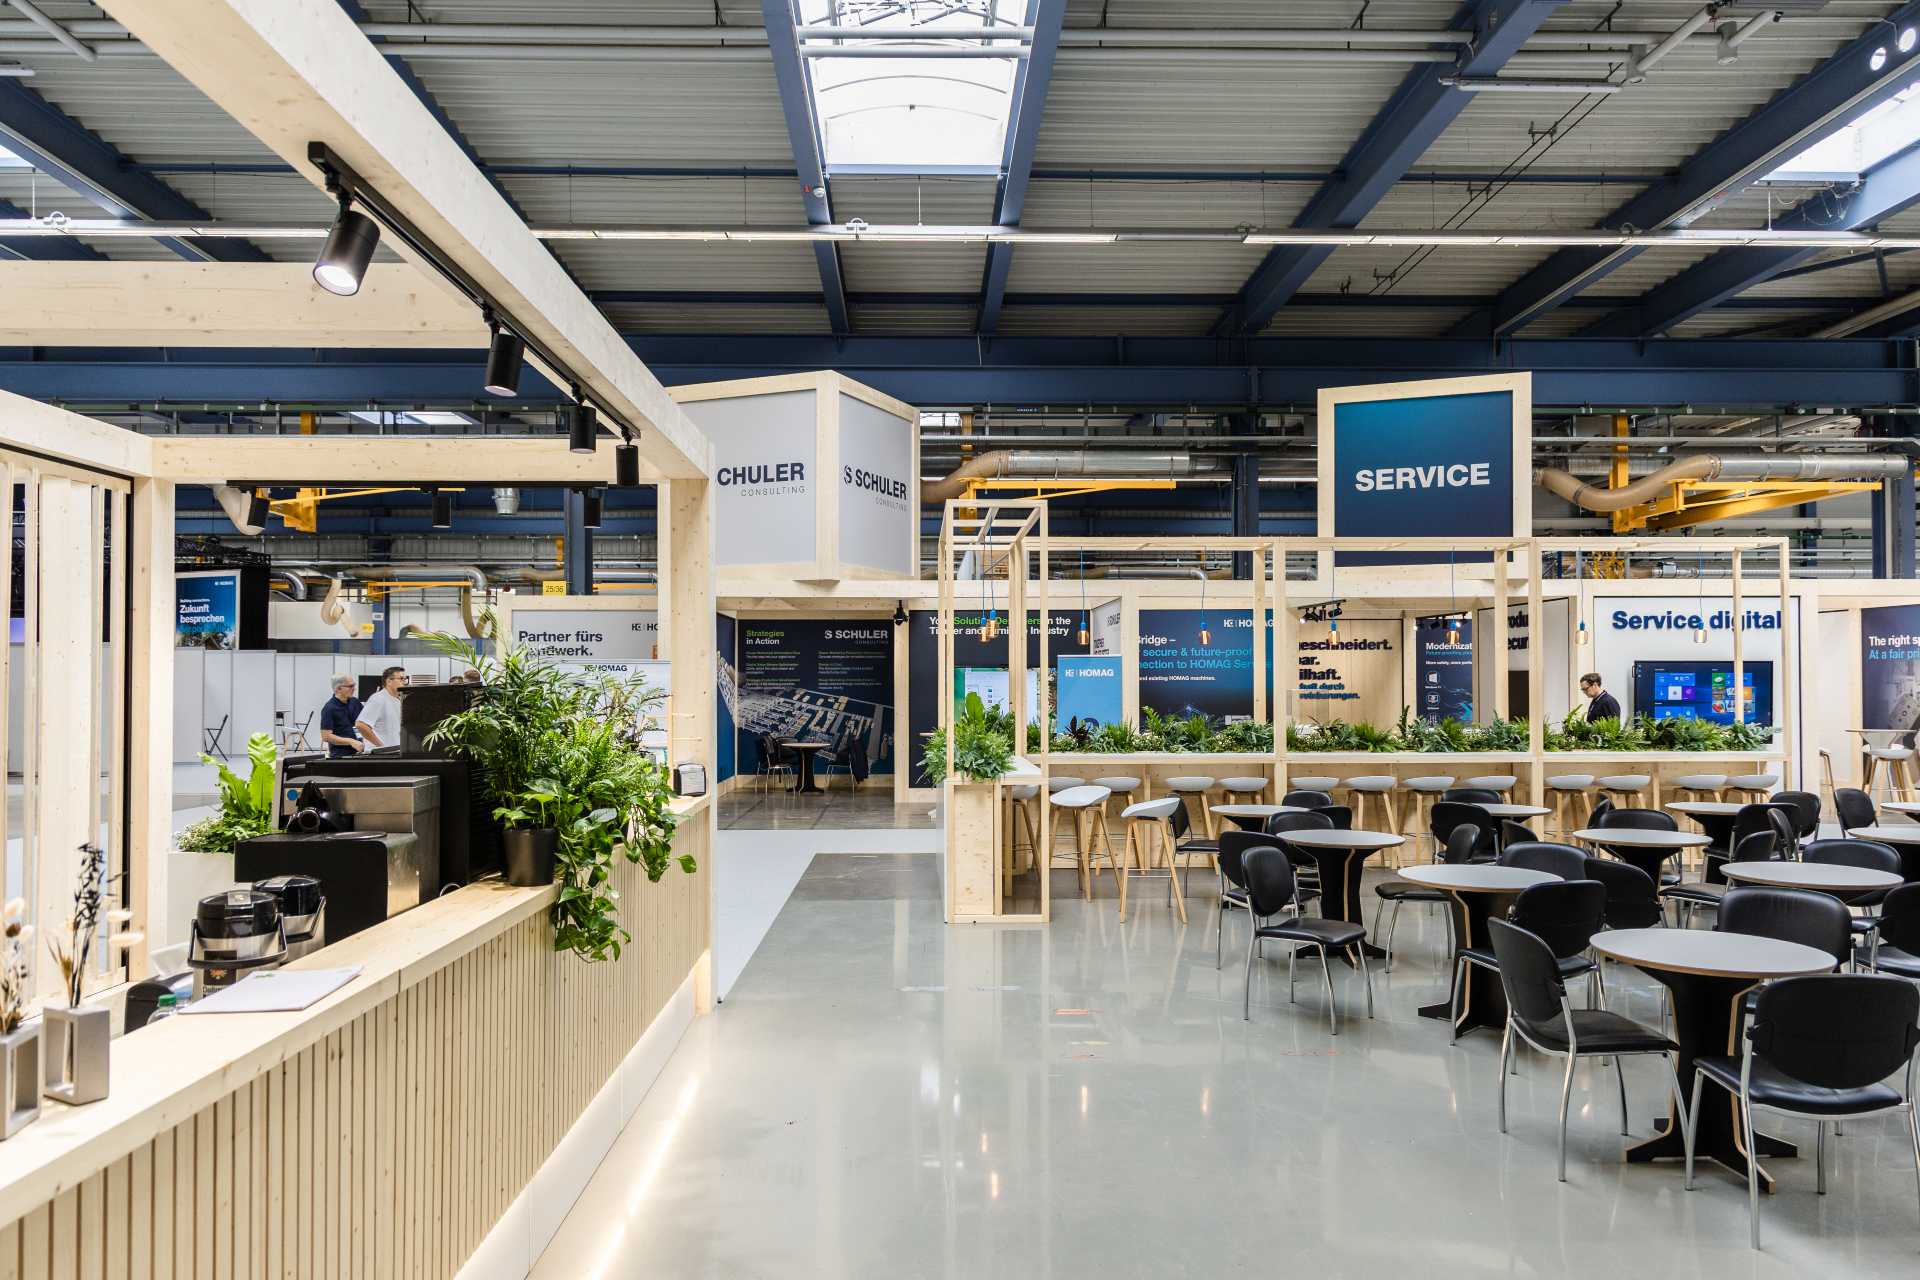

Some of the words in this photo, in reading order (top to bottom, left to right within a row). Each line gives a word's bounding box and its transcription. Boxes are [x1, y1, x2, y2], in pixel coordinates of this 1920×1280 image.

[716, 462, 805, 485] CHULER
[1355, 463, 1490, 491] SERVICE
[855, 469, 907, 500] SCHULER
[741, 486, 805, 497] CONSULTING
[179, 604, 209, 613] Zukunft
[180, 614, 225, 624] besprechen
[1055, 616, 1071, 625] the
[1612, 610, 1704, 630] Service
[518, 630, 571, 642] Partner
[575, 630, 603, 642] fürs
[746, 630, 785, 638] Strategies
[835, 630, 888, 639] SCHULER
[929, 626, 964, 635] Tier
[1030, 626, 1069, 636] Inustry
[1299, 638, 1393, 651] eschneidert.
[1425, 642, 1473, 650] Modernizat
[1868, 636, 1886, 646] The
[1888, 635, 1911, 648] right
[1143, 648, 1178, 657] secure
[1180, 648, 1188, 657] &
[1869, 649, 1879, 659] At
[1889, 649, 1904, 659] fair
[1907, 649, 1920, 660] pri
[1177, 660, 1187, 669] to
[1190, 659, 1231, 669] HOMAG
[1079, 669, 1114, 677] HOMAG
